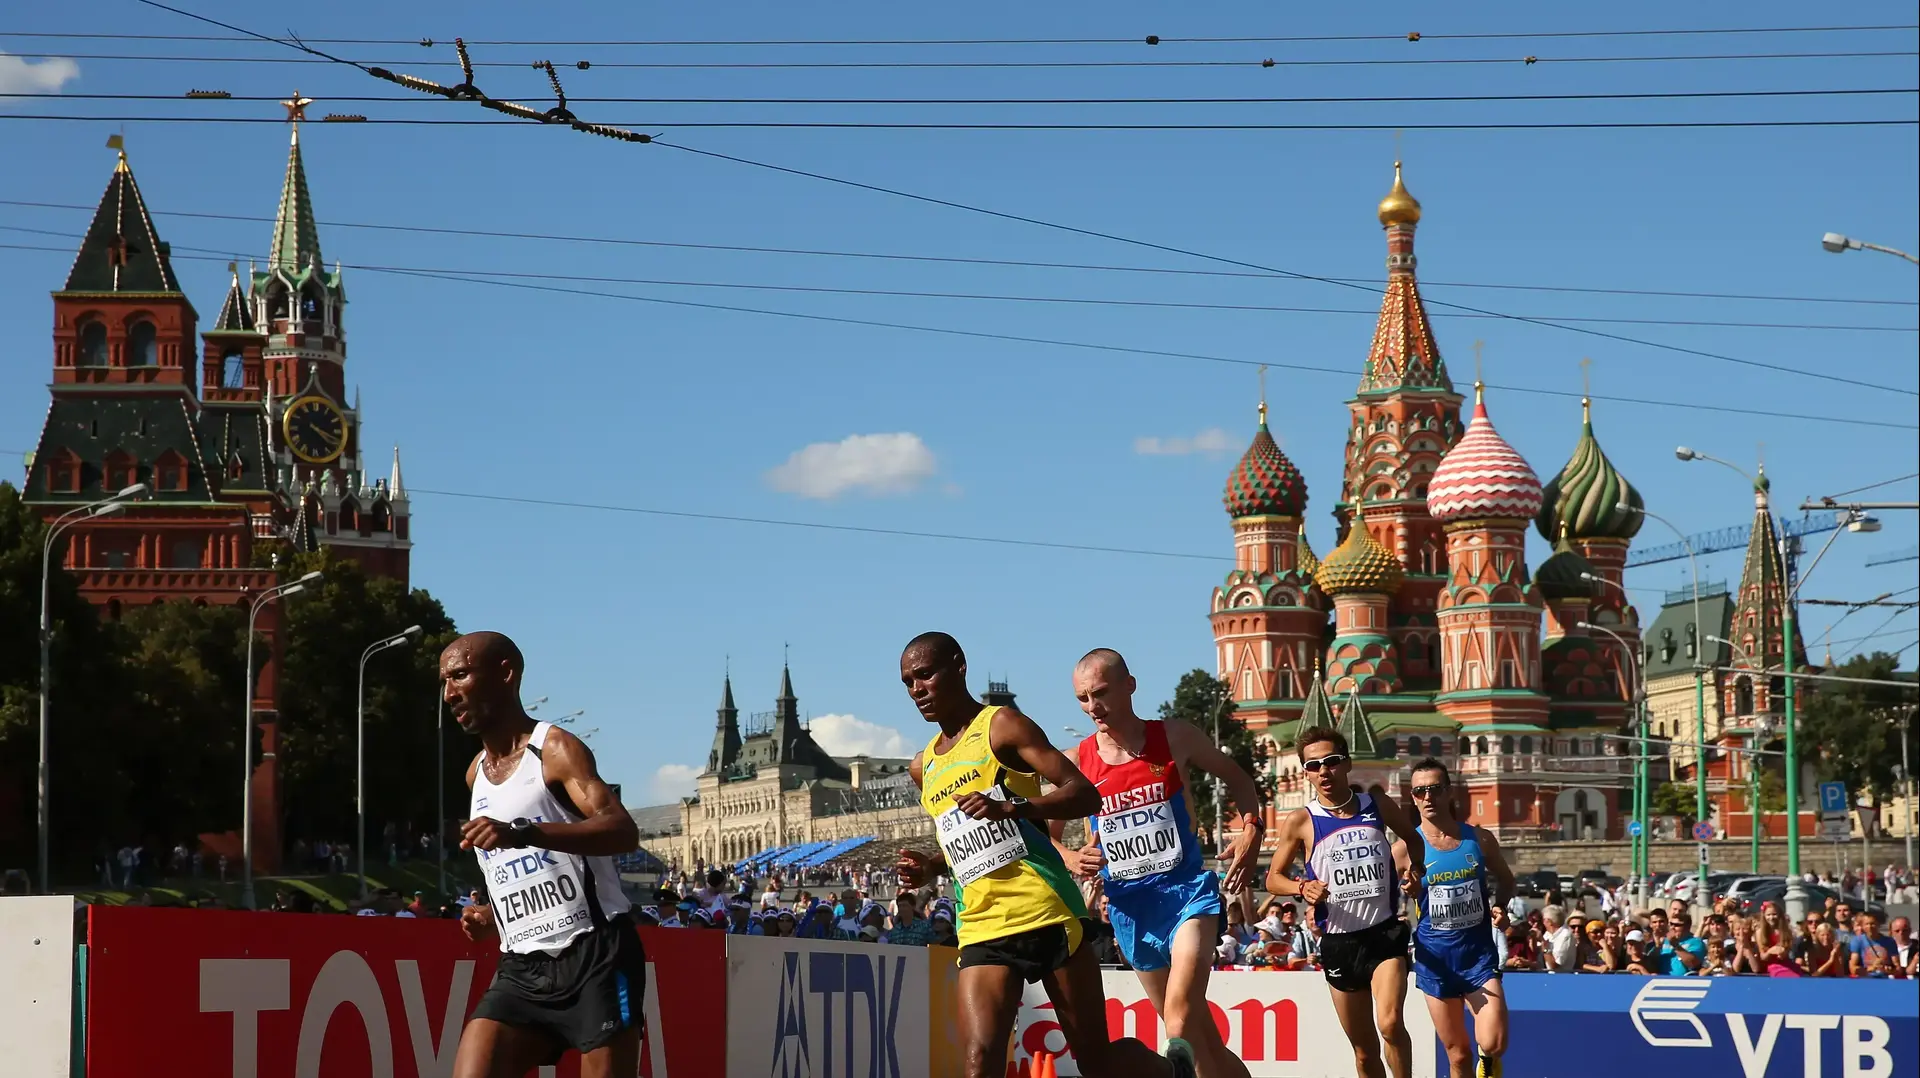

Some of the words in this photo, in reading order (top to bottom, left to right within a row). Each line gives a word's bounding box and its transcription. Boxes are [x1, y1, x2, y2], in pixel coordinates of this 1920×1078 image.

[929, 768, 982, 806] TANZANIA
[1099, 782, 1165, 815] RUSSIA
[1826, 786, 1840, 808] P
[1114, 805, 1167, 830] TDK
[945, 818, 1017, 866] MSANDEKI
[1106, 827, 1176, 863] SOKOLOV
[1336, 828, 1368, 845] TPE
[505, 849, 560, 879] TDK
[958, 858, 996, 884] MOSCOW
[997, 845, 1025, 863] 2013
[1343, 844, 1382, 861] TDK
[1112, 864, 1156, 879] MOSCOW
[1333, 862, 1385, 887] CHANG
[1426, 867, 1477, 885] UKRAINE
[500, 874, 577, 924] ZEMIRO
[1334, 888, 1373, 900] MOSCOW
[1443, 881, 1476, 899] TDK
[1431, 897, 1483, 919] MATVIYCHUK
[509, 921, 555, 946] MOSCOW
[557, 909, 588, 929] 2013
[1432, 921, 1466, 929] MOSCOW
[809, 952, 907, 1078] TDK
[1014, 998, 1298, 1061] ann
[1724, 1012, 1894, 1078] VTB
